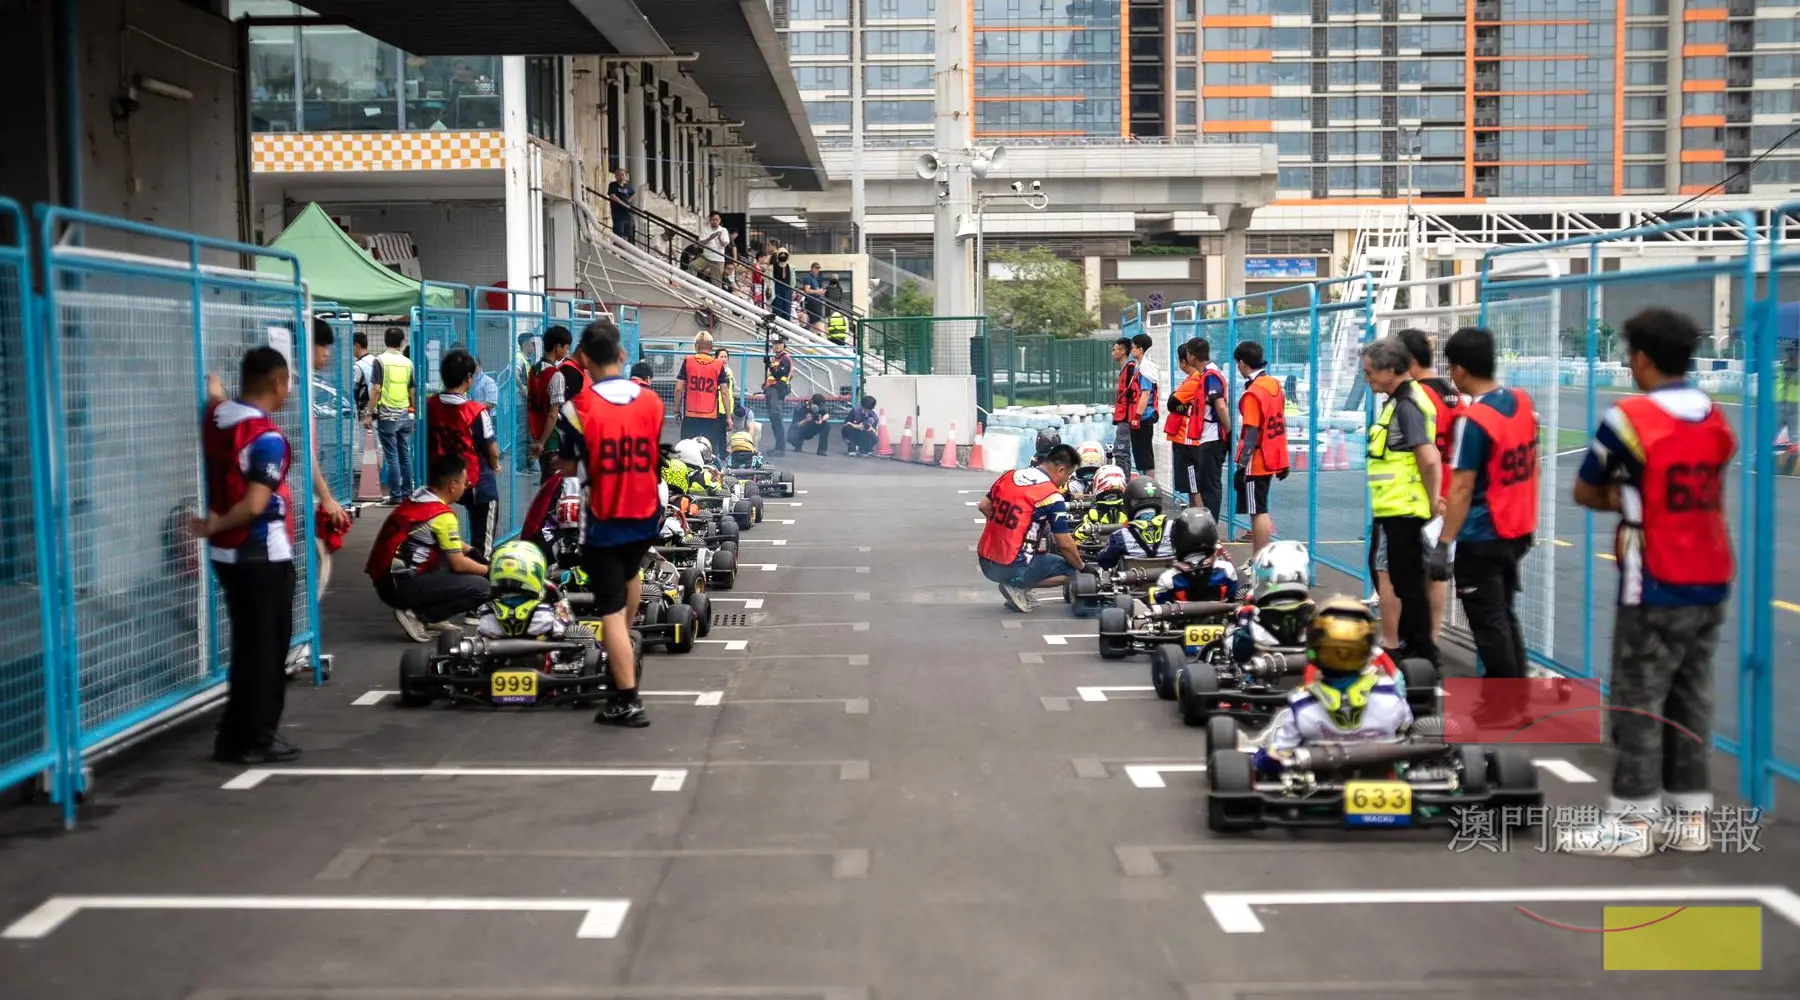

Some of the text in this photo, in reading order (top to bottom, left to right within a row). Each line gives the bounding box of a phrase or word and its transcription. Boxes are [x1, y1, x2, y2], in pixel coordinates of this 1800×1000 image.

[690, 376, 714, 393] 902
[494, 676, 533, 692] 999
[1353, 788, 1406, 809] 633
[1362, 815, 1396, 823] MACAU
